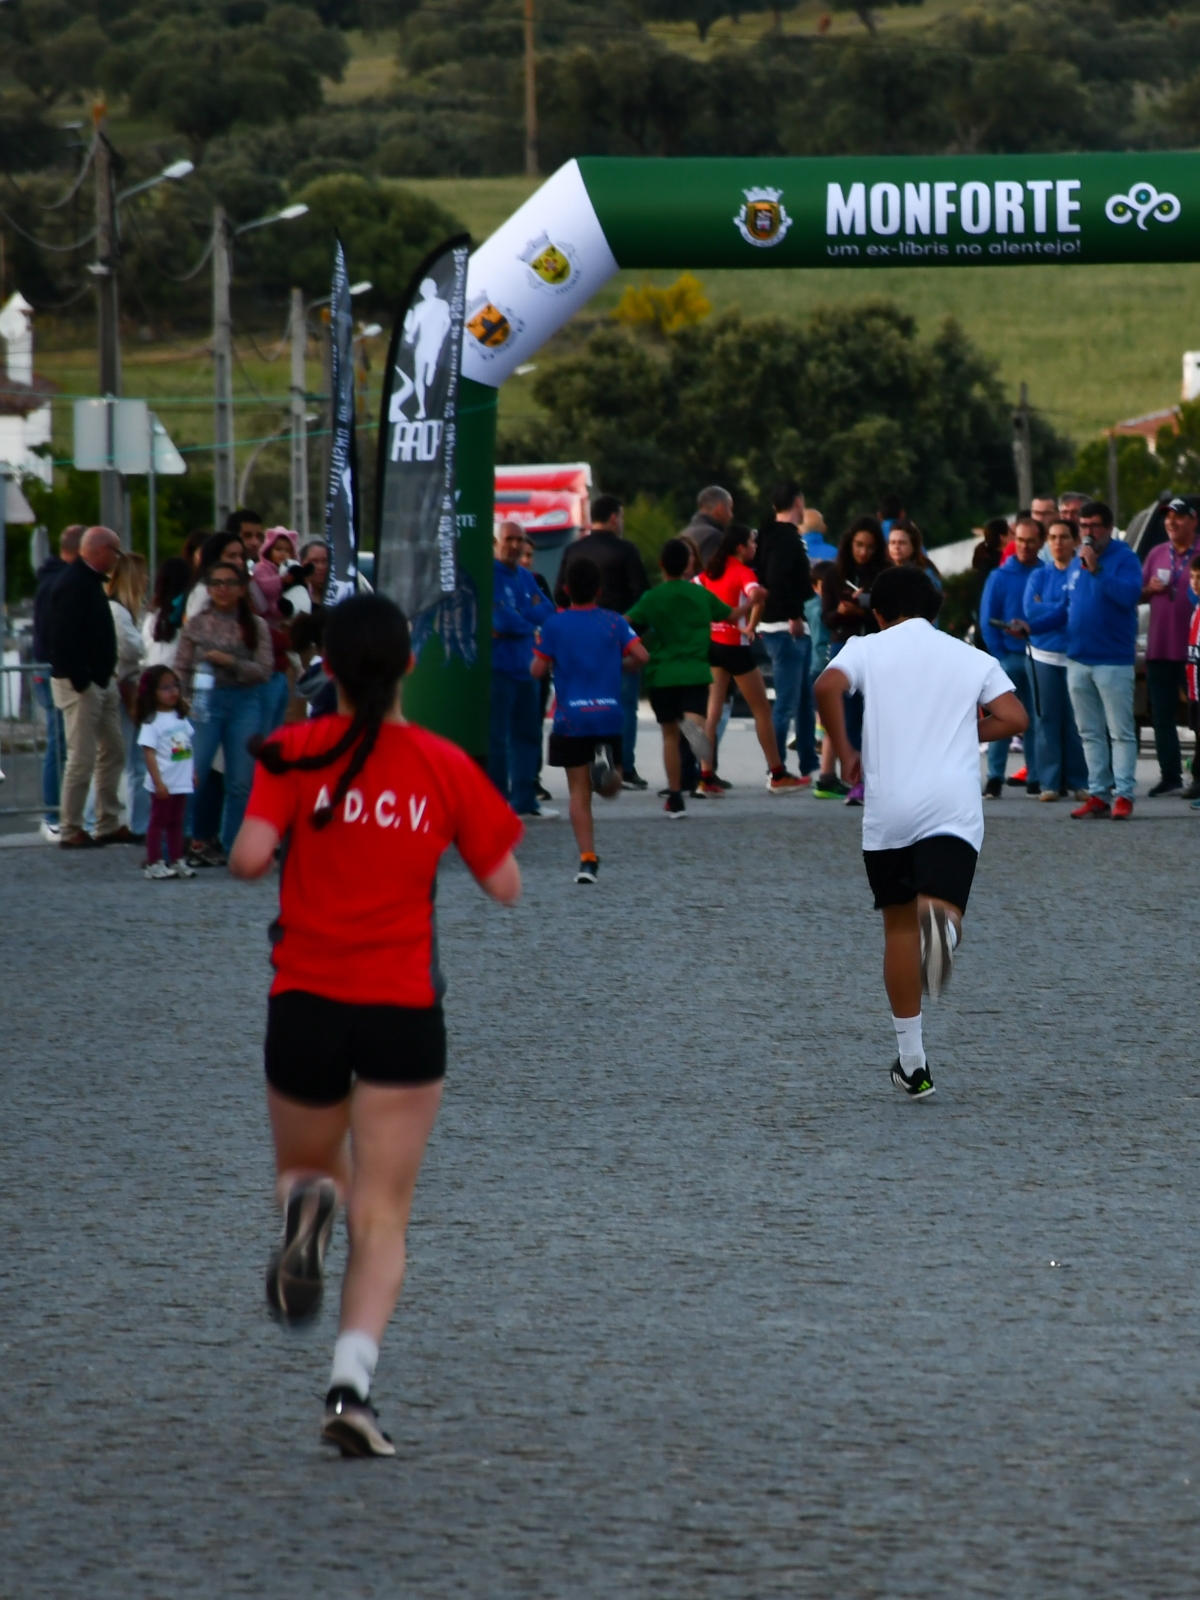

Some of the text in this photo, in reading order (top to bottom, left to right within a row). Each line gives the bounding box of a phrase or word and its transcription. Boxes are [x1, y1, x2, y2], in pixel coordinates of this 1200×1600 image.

[826, 180, 1081, 235] MONFORTE
[826, 245, 860, 256] um
[955, 243, 982, 255] no
[988, 239, 1081, 256] alentejo!
